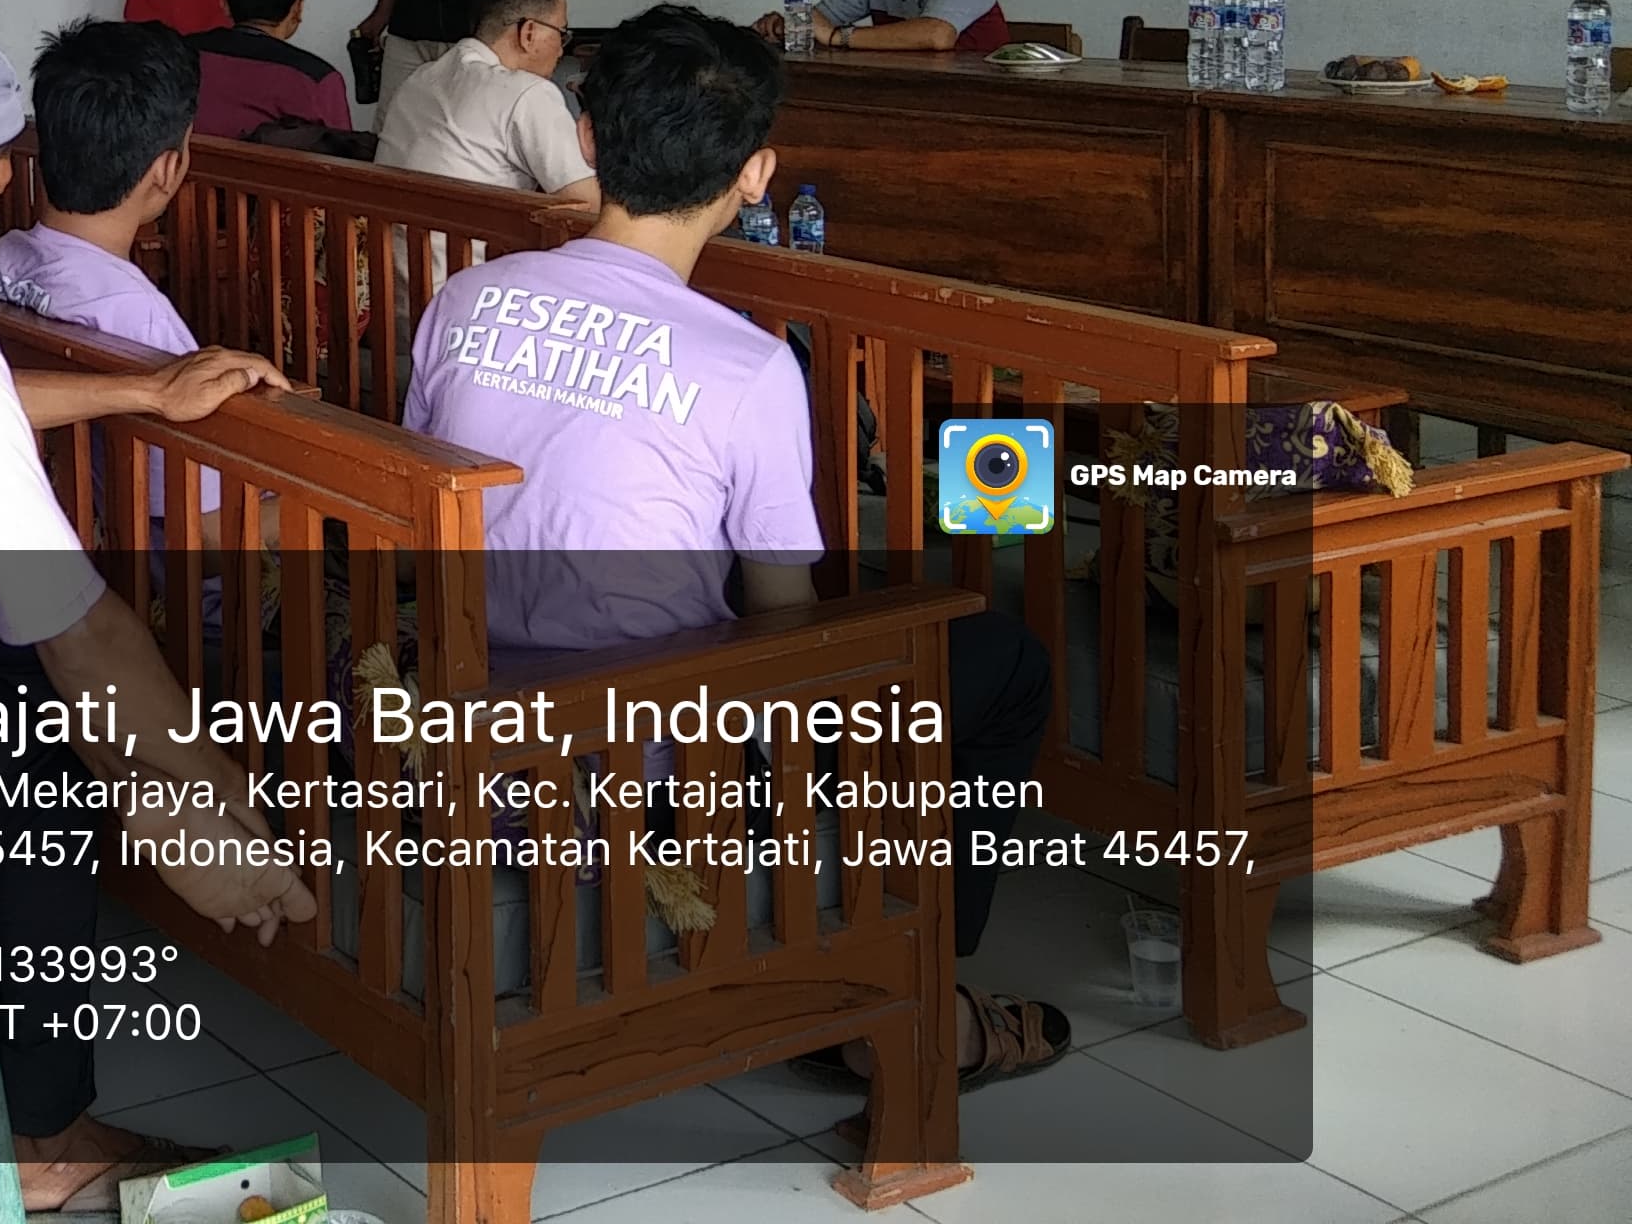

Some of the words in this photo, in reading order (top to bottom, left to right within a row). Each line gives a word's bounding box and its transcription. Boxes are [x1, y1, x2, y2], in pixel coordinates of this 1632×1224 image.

[470, 286, 673, 367] PESERTA
[442, 325, 701, 425] PELATIHAN
[473, 370, 551, 401] KERTASARI
[553, 388, 624, 419] MAKMUR
